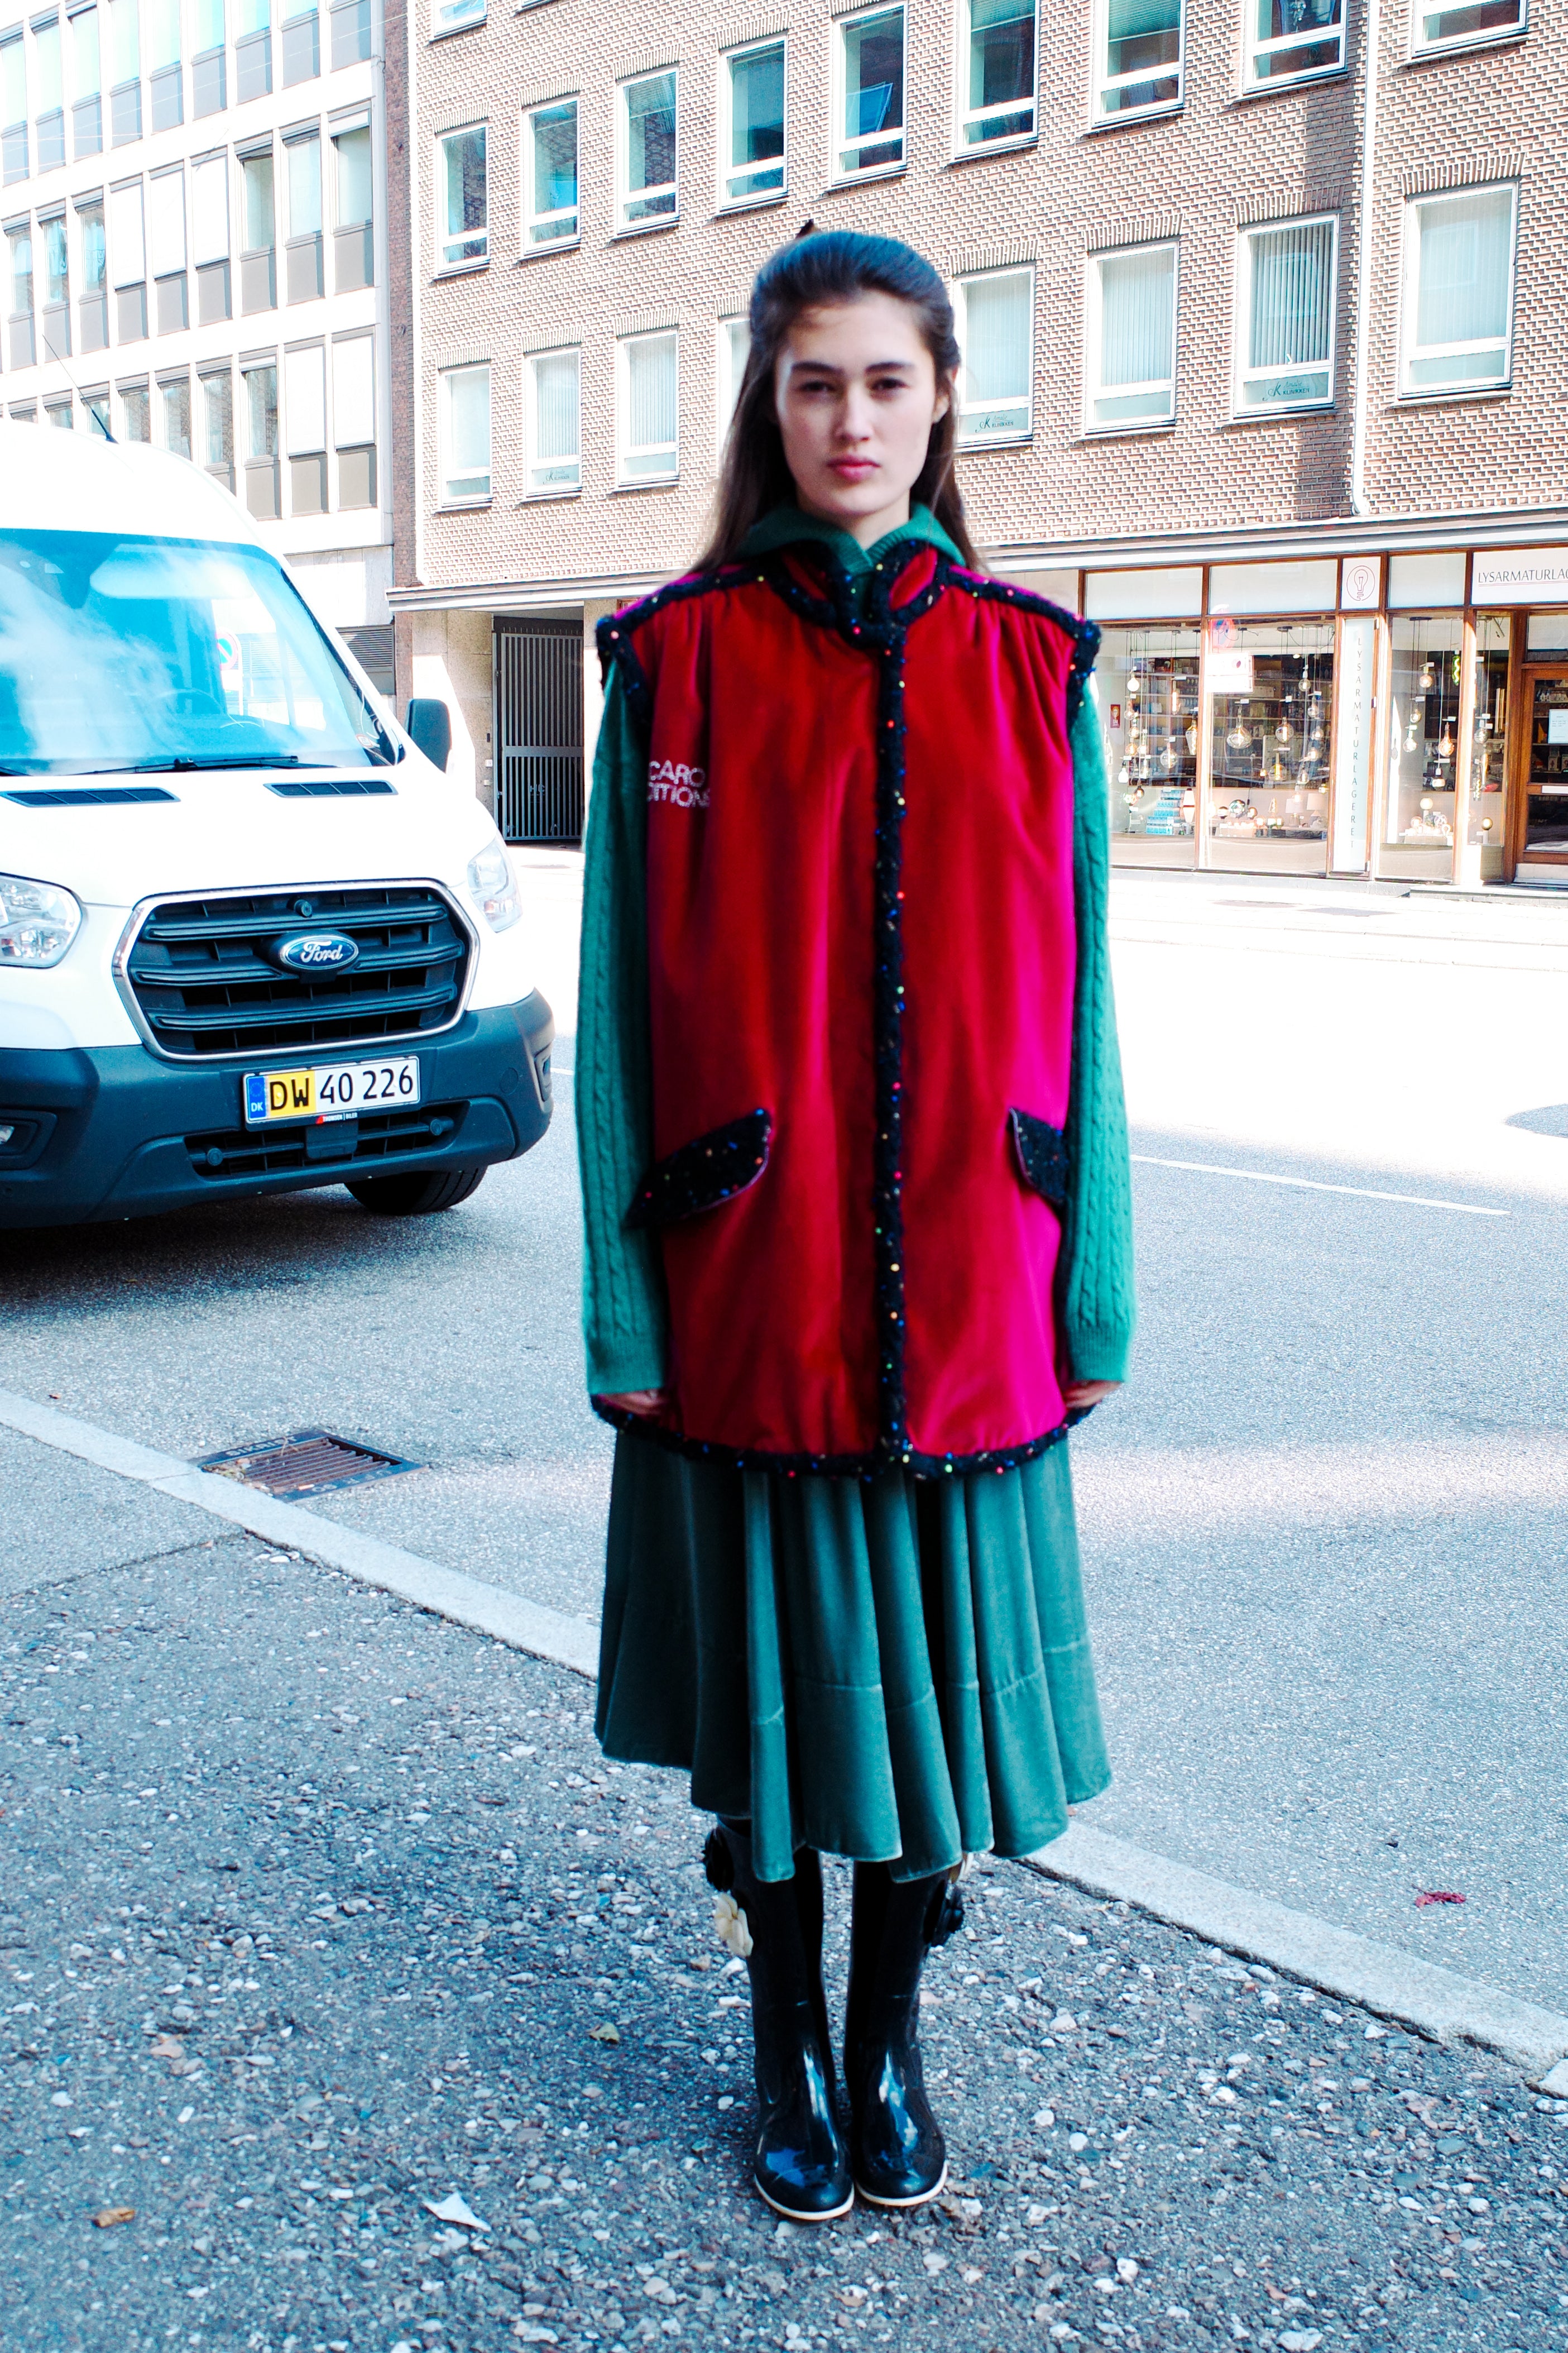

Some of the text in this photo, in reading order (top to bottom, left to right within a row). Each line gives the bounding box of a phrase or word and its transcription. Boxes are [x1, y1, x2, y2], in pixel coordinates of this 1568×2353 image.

[1350, 637, 1362, 848] LYSARMATURLAGERET
[648, 759, 706, 788] CARO
[300, 941, 343, 963] Ford
[270, 1065, 414, 1111] DW 40 226
[251, 1102, 263, 1112] DK
